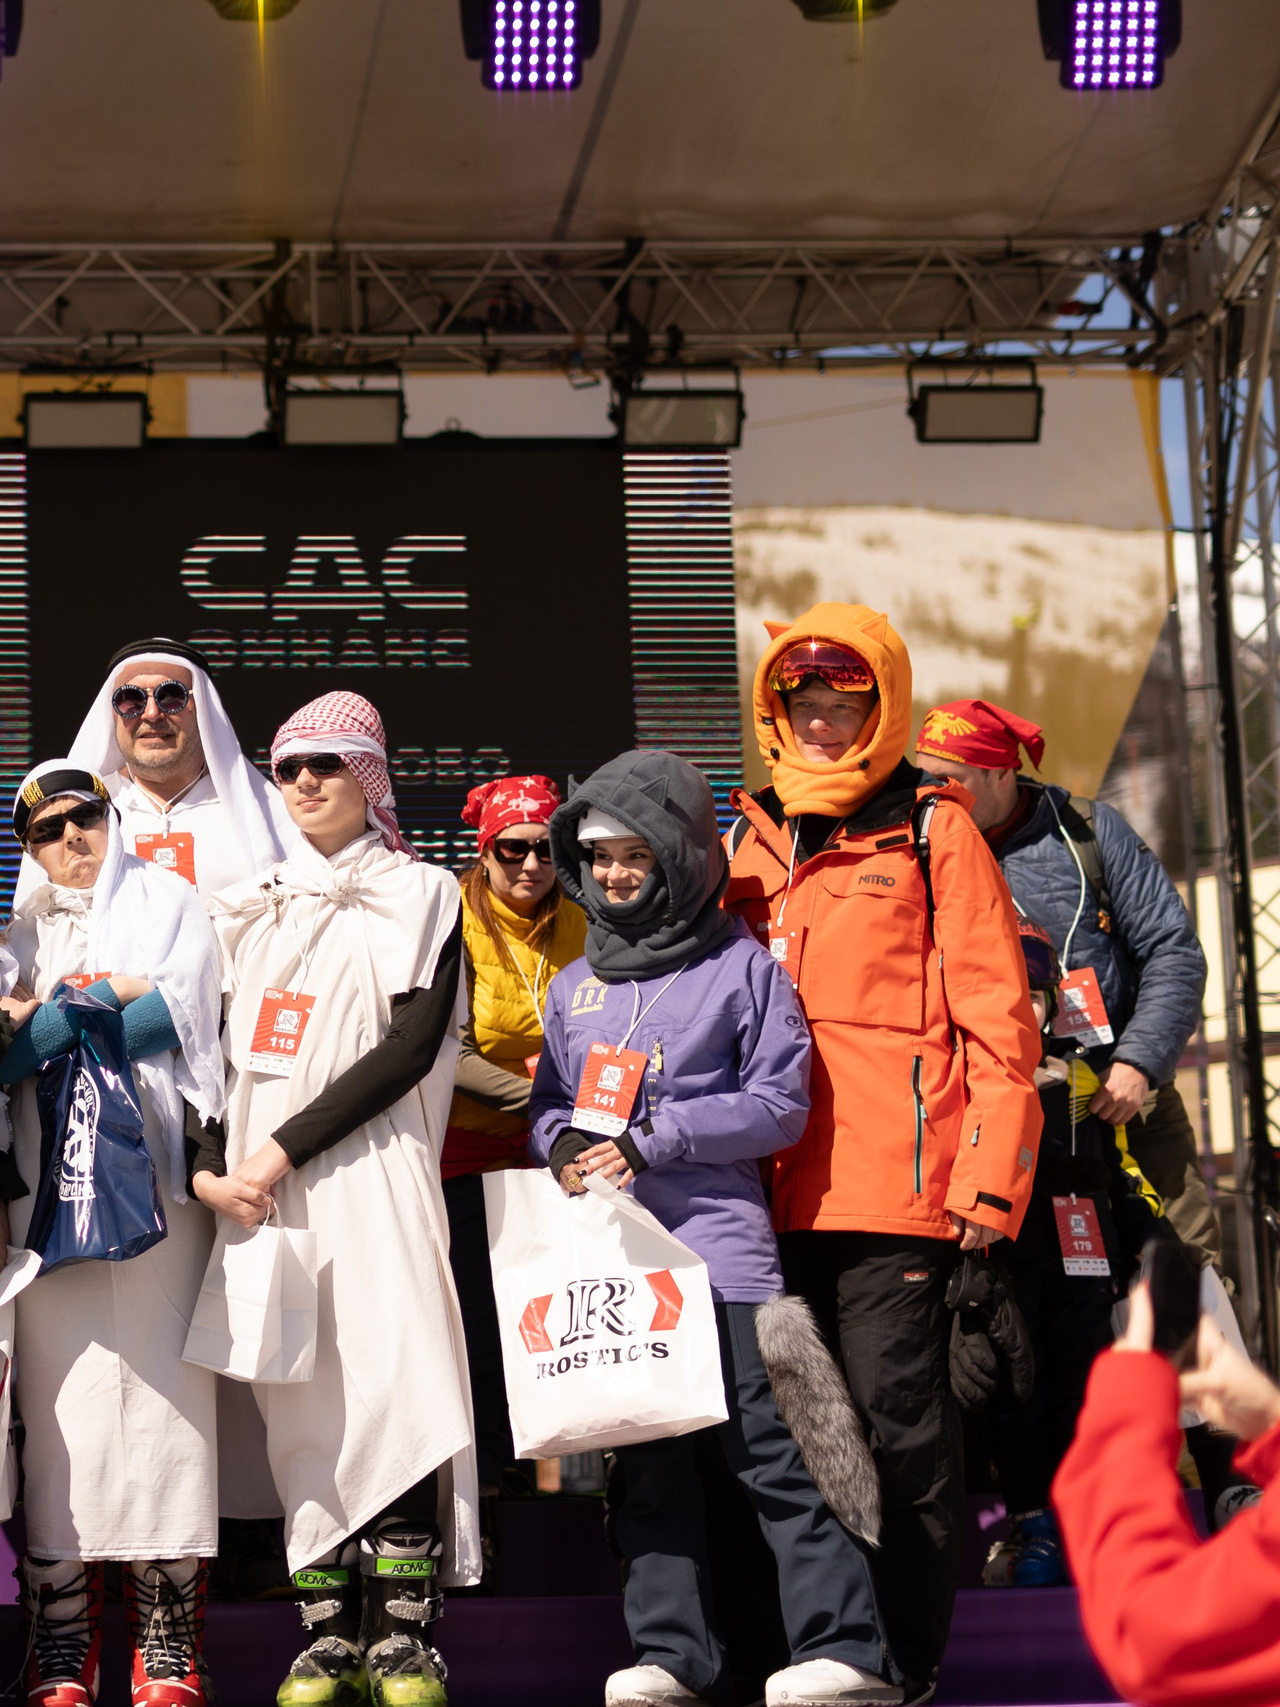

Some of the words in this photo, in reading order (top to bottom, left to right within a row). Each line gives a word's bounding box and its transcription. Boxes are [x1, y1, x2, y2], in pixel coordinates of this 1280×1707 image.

[858, 874, 896, 887] NITRO
[571, 984, 609, 1008] DRK
[1066, 1011, 1091, 1026] 155
[270, 1036, 295, 1050] 115
[593, 1092, 616, 1108] 141
[1073, 1240, 1092, 1251] 179
[536, 1341, 669, 1380] ROSTIC'S
[391, 1560, 431, 1575] ATOMIC
[297, 1574, 335, 1587] ATOMIC
